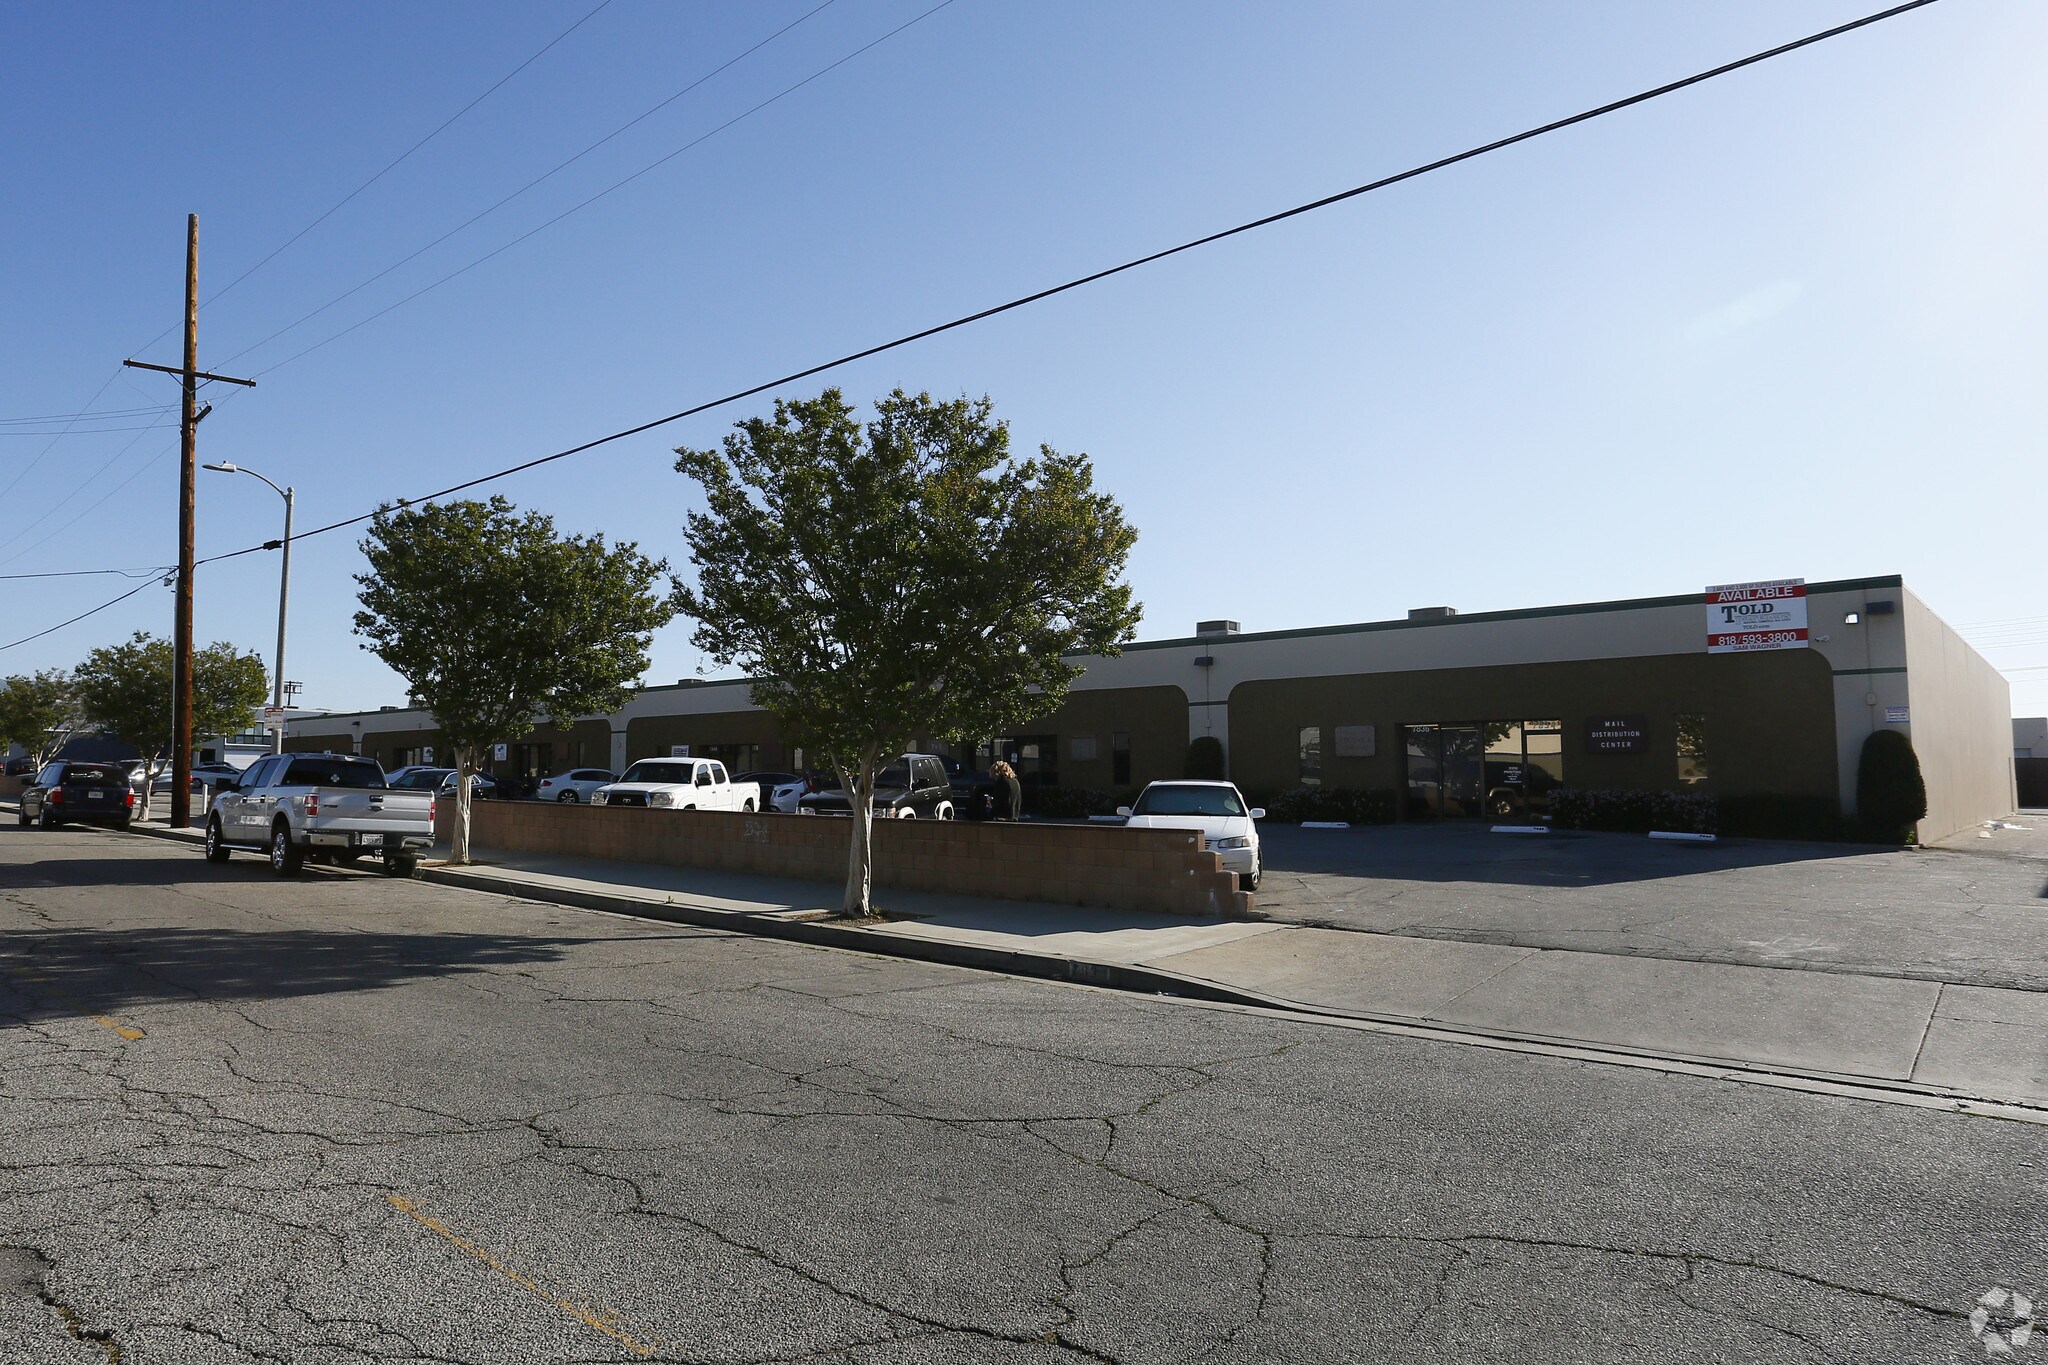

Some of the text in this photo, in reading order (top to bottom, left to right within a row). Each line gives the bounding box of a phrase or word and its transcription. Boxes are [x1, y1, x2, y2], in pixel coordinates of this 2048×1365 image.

[1718, 586, 1794, 602] AVAILABLE
[1721, 603, 1774, 624] TOLD
[1718, 632, 1797, 646] 818/593-3800
[1591, 730, 1640, 738] DISTRIBUTION
